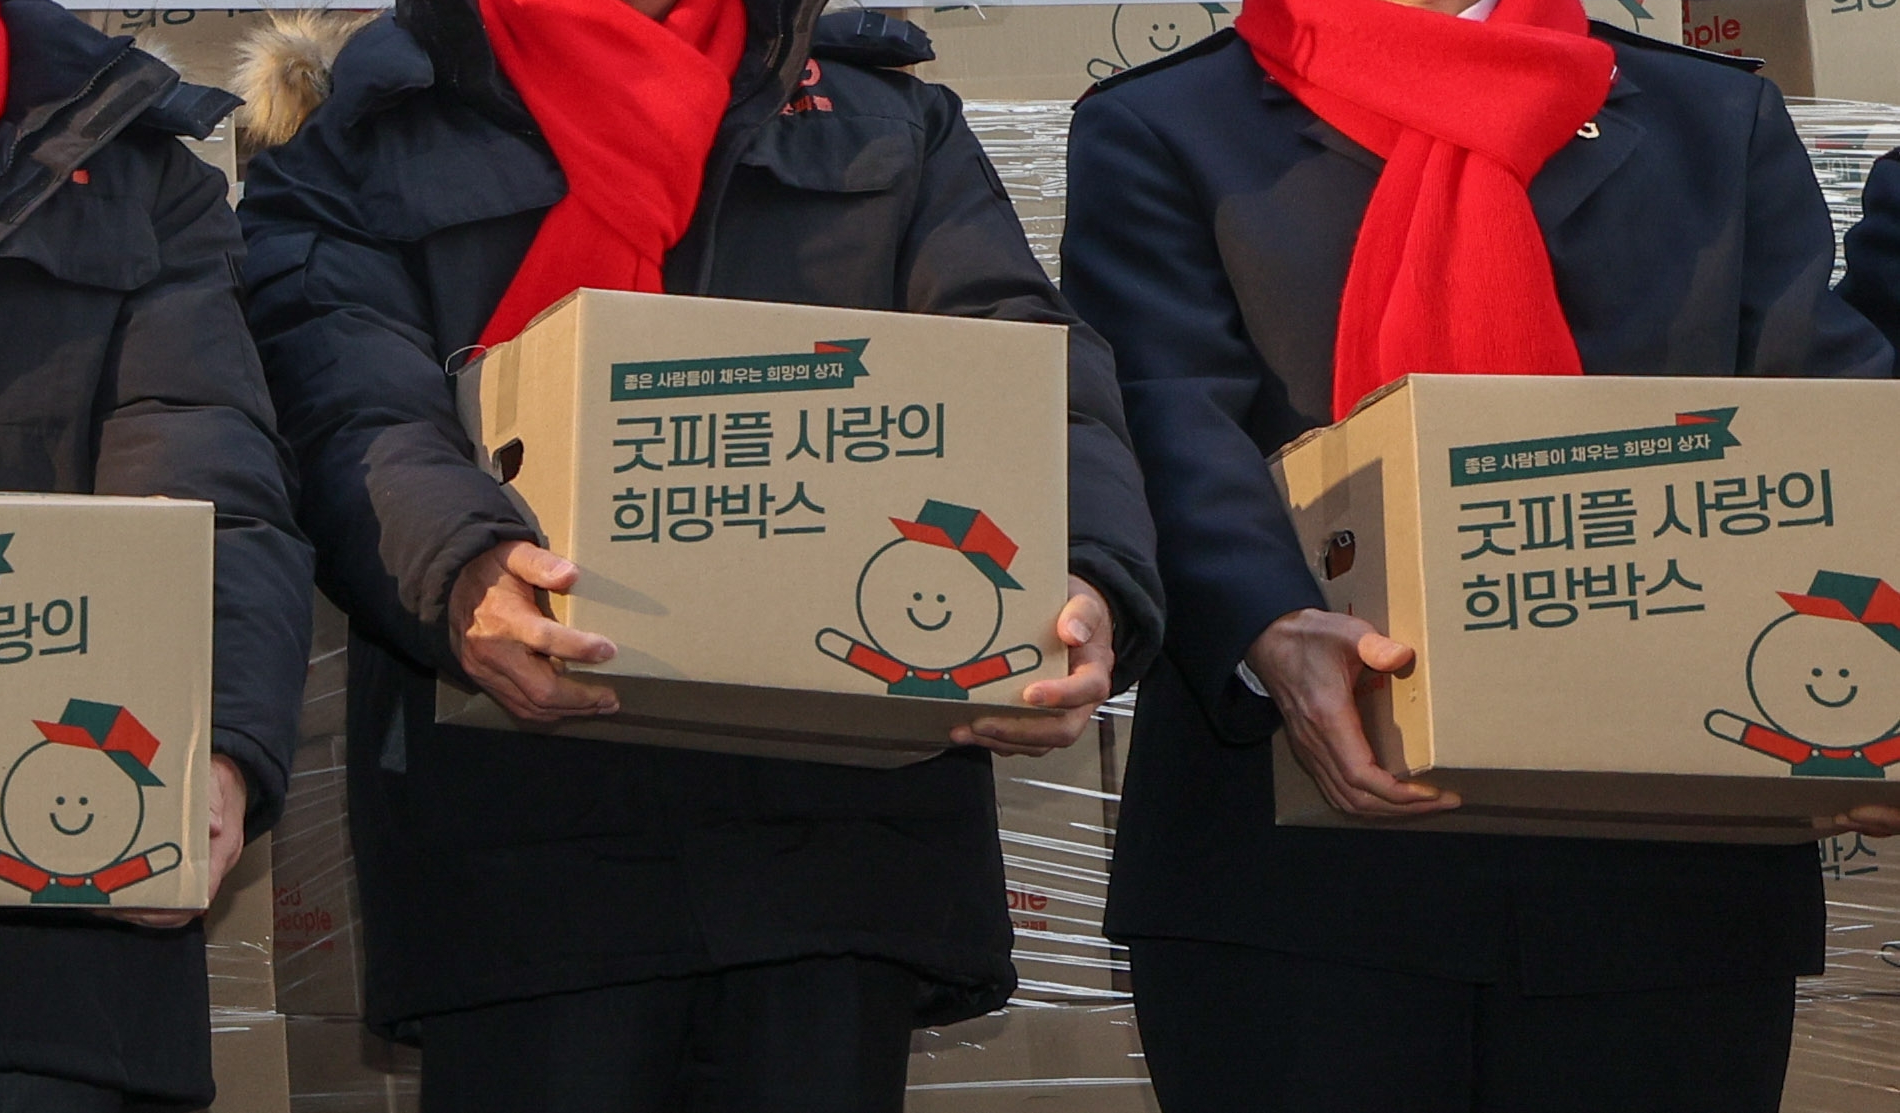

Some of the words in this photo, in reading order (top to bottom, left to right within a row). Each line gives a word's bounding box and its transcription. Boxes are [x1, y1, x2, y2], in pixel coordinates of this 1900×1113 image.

[624, 372, 653, 391] 좋은
[656, 369, 715, 388] 사람들이
[719, 367, 763, 384] 채우는
[766, 364, 810, 382] 희망의
[813, 362, 844, 380] 상자
[613, 412, 773, 473] 굿피플
[786, 403, 944, 463] 사랑의
[1464, 455, 1497, 475] 좋은
[1501, 447, 1566, 470] 사람들이
[1570, 443, 1619, 462] 채우는
[1624, 437, 1673, 457] 희망의
[1677, 433, 1711, 452] 상자
[611, 482, 825, 543] 희망박스
[1458, 489, 1637, 560] 굿피플
[1654, 469, 1833, 538] 사랑의
[1463, 559, 1705, 631] 희망박스
